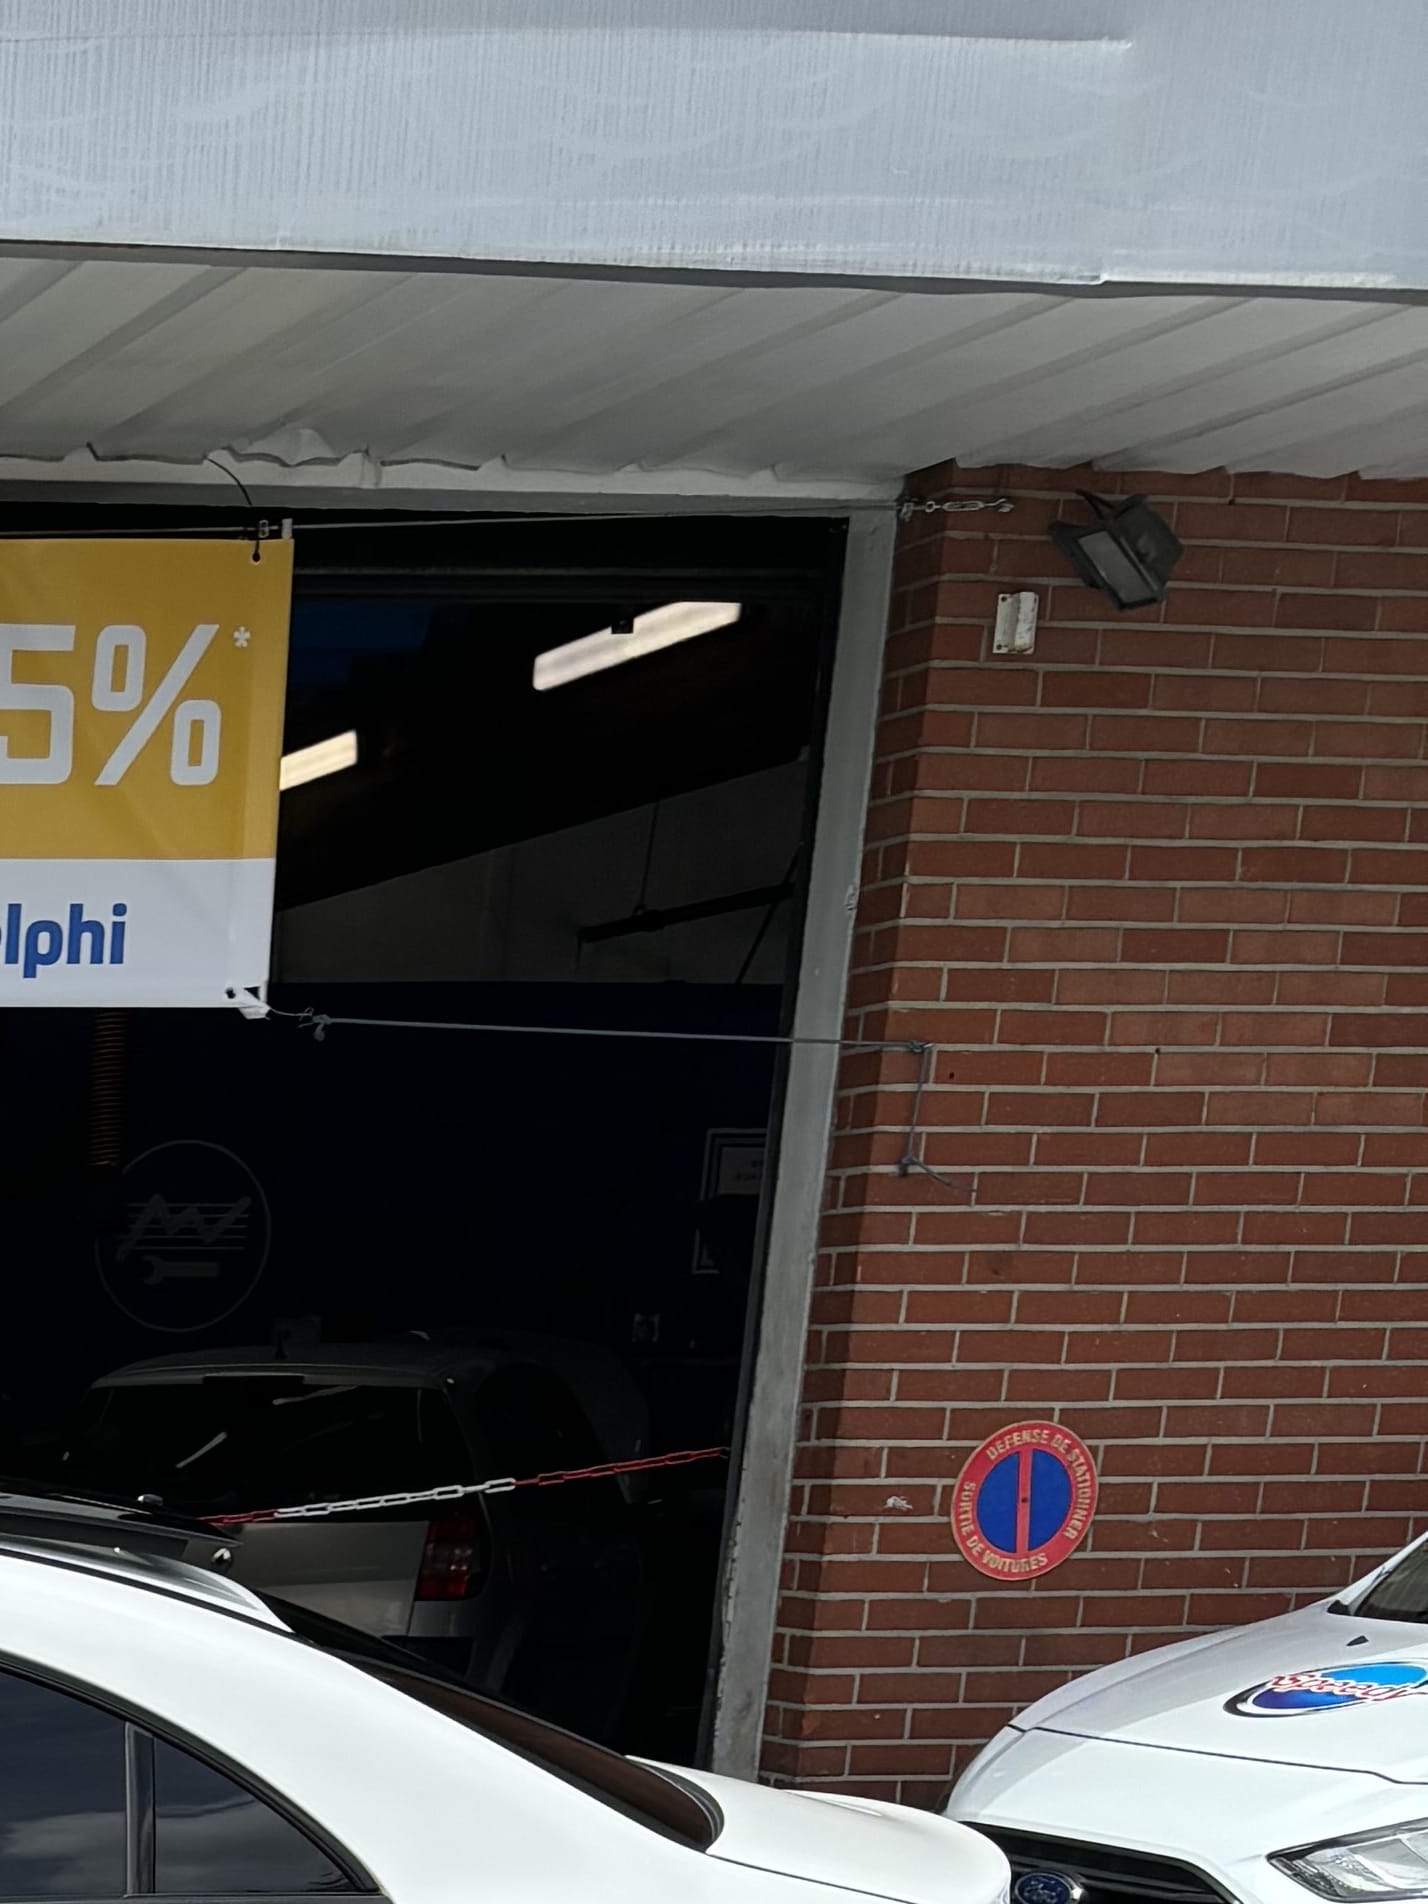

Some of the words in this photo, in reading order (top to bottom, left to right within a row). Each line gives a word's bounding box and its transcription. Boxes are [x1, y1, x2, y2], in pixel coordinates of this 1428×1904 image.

[1052, 1434, 1072, 1453] DE
[1063, 1448, 1092, 1540] STATIONNER
[958, 1481, 976, 1536] SORTIE
[966, 1535, 985, 1556] DE
[982, 1550, 1048, 1573] VOITURES
